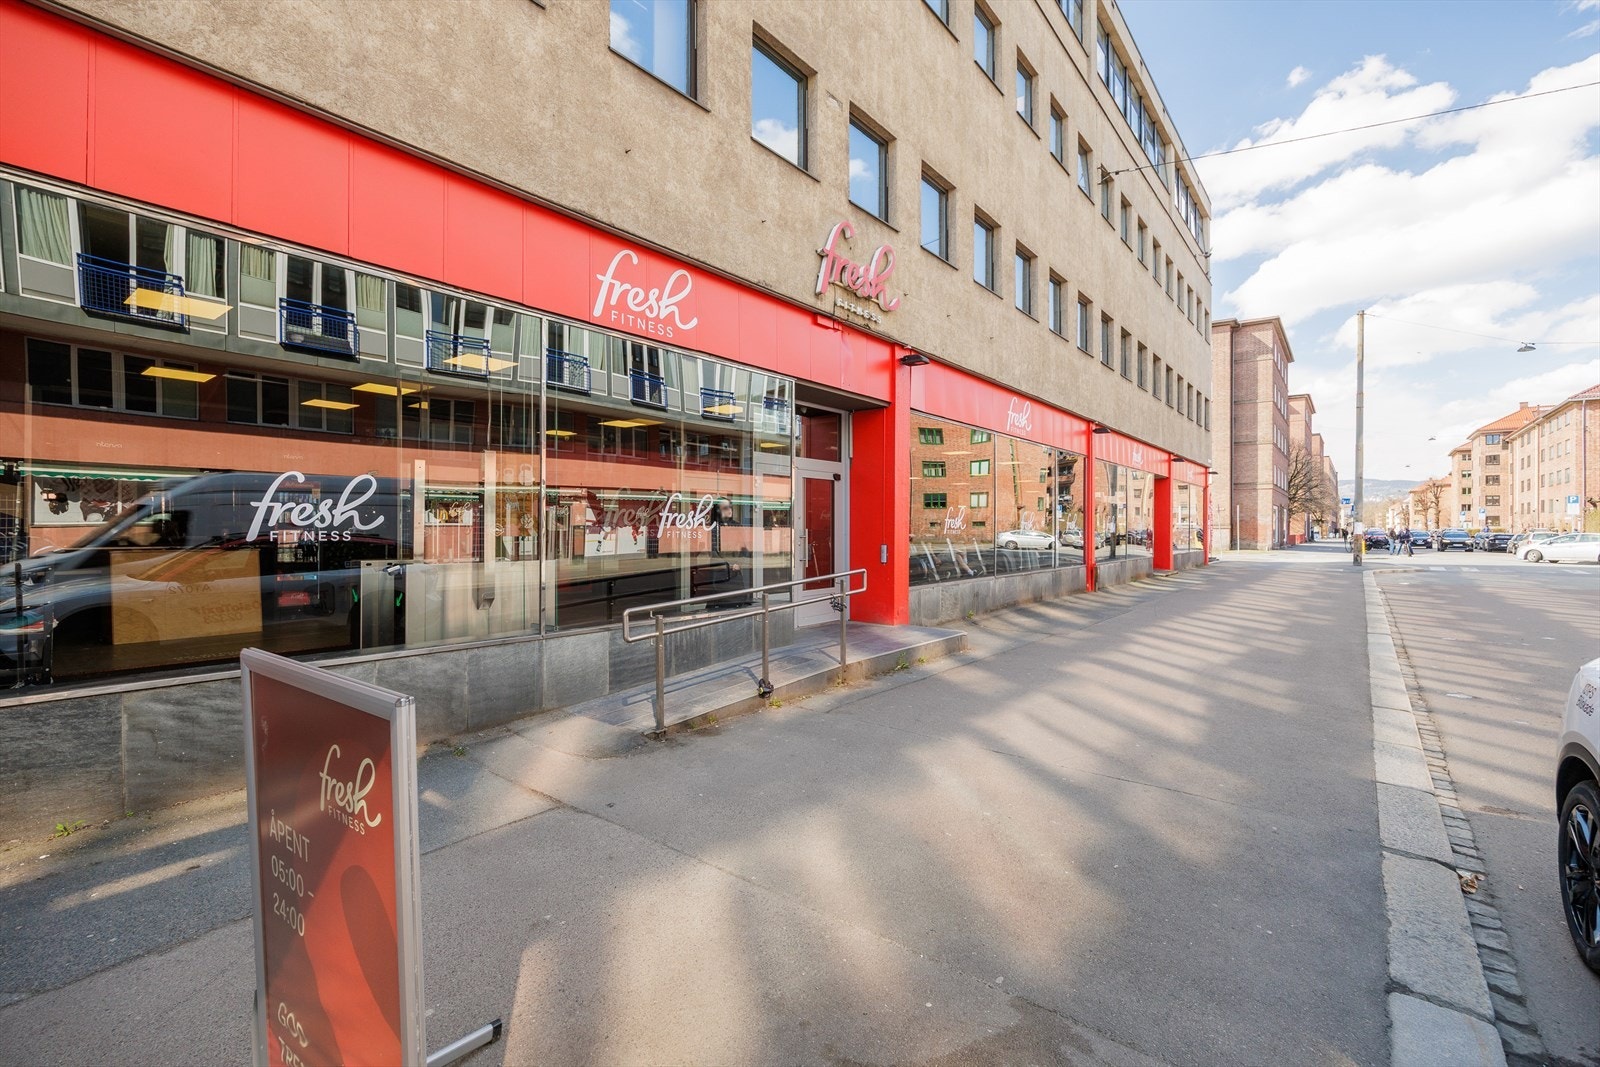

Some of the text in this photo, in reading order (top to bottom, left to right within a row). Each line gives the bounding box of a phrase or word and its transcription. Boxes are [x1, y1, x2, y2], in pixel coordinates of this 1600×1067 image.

[815, 221, 900, 312] fresh
[593, 249, 698, 330] fresh
[835, 298, 882, 324] FITNESS
[611, 310, 674, 338] FITNESS
[1007, 396, 1032, 432] fresh
[245, 470, 385, 542] fresh
[657, 492, 717, 539] fresh
[944, 506, 967, 535] fresh
[269, 530, 352, 542] FITNESS
[666, 531, 702, 539] FITNESS
[319, 744, 382, 828] fresh
[269, 808, 310, 863] ÅPENT
[328, 804, 366, 836] FITNESS
[273, 892, 305, 937] 24:00
[277, 1002, 309, 1048] GOD
